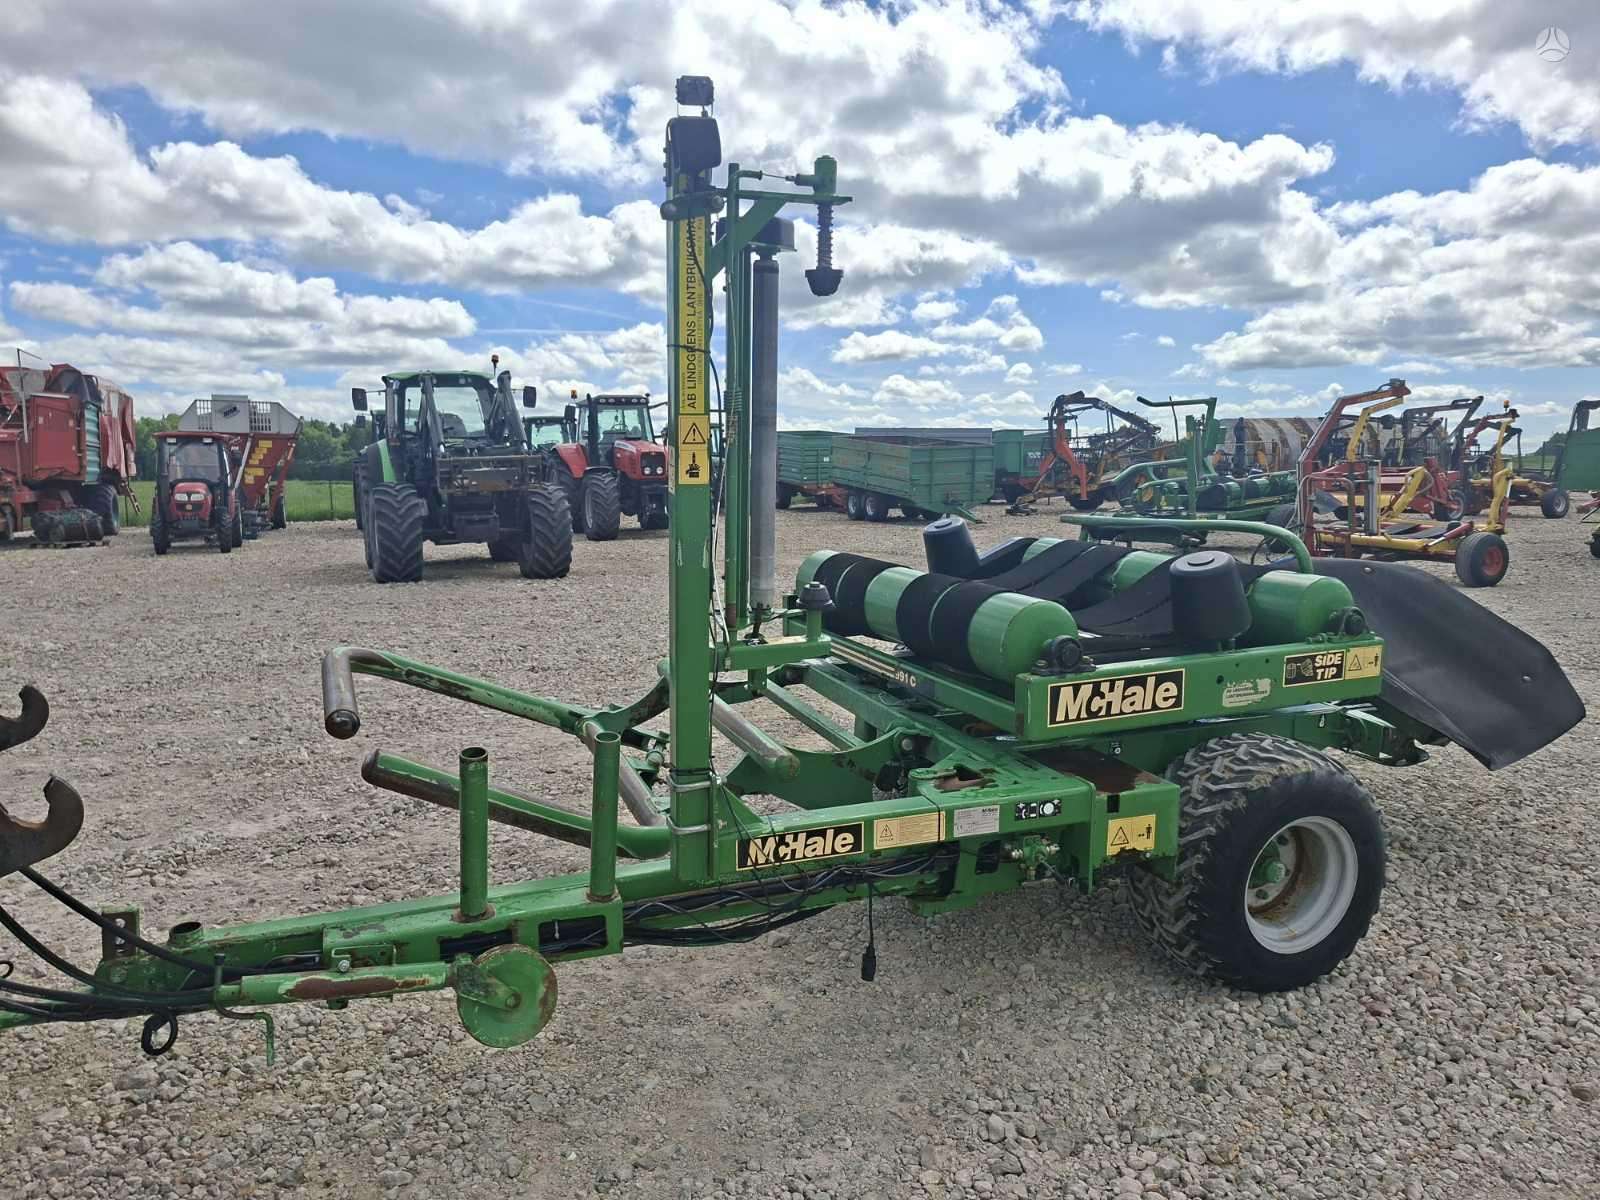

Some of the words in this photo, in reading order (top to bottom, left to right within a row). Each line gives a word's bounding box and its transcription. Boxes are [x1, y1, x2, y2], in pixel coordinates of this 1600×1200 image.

[686, 320, 697, 390] LINDGRENS
[687, 393, 697, 410] AB
[1314, 653, 1343, 667] SIDE
[1315, 667, 1337, 680] TIP
[1056, 675, 1178, 722] McHale
[746, 829, 854, 865] McHale
